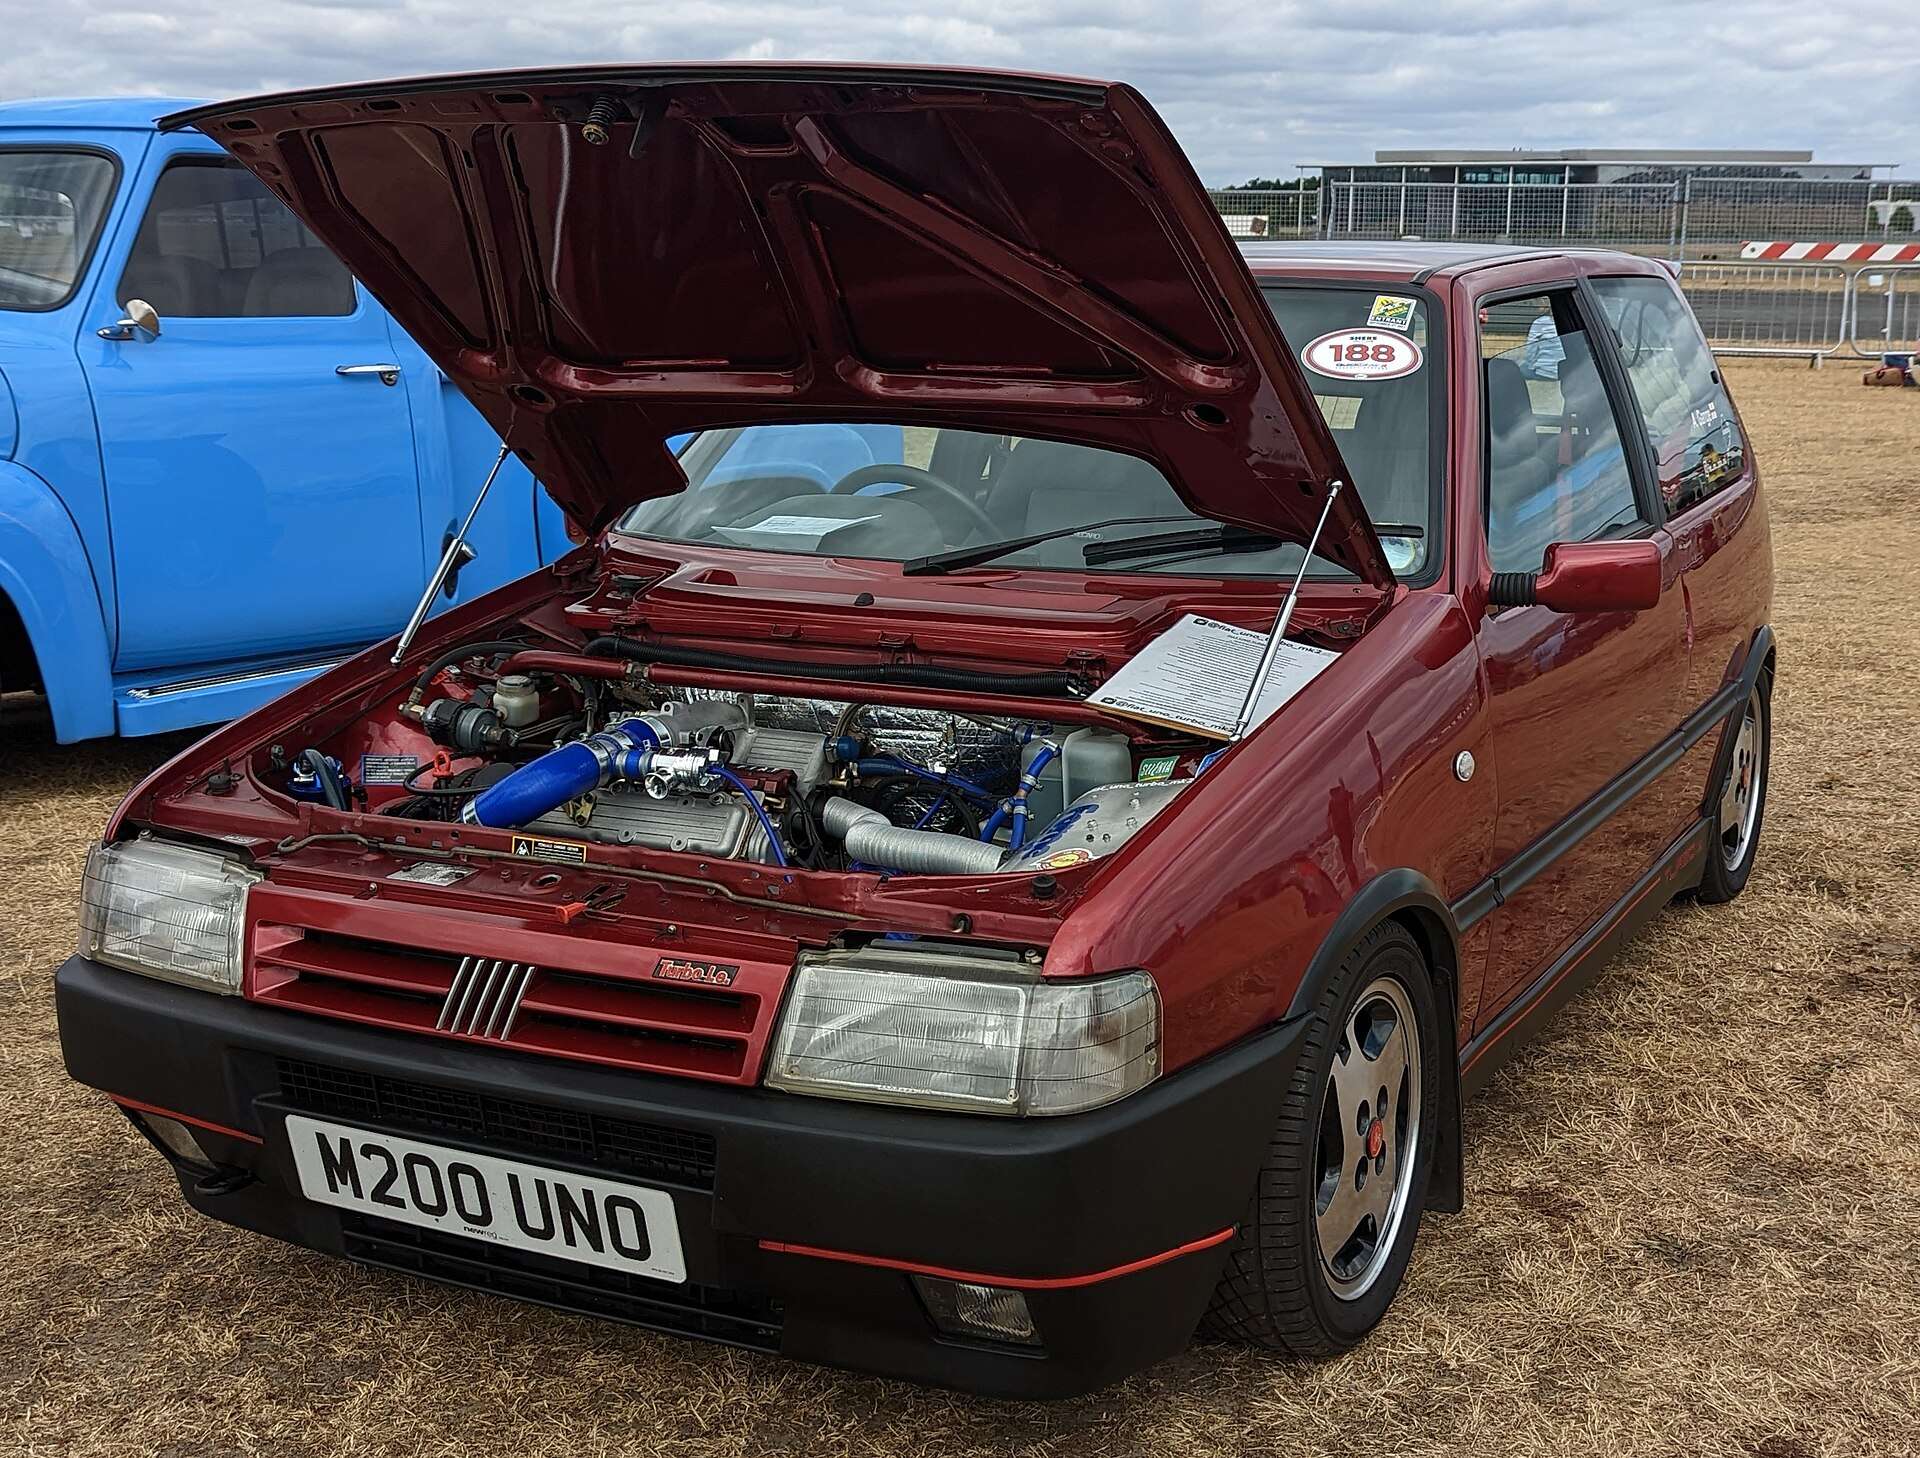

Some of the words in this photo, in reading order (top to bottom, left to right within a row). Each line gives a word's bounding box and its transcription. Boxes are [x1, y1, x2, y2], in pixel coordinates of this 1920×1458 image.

[1370, 316, 1407, 326] ENTRANT
[1329, 343, 1396, 363] 188
[1207, 621, 1322, 655] @fiat_uno_tbo_mk2
[660, 959, 704, 982] Turbo
[315, 1130, 494, 1228] M200
[506, 1172, 652, 1263] UNO
